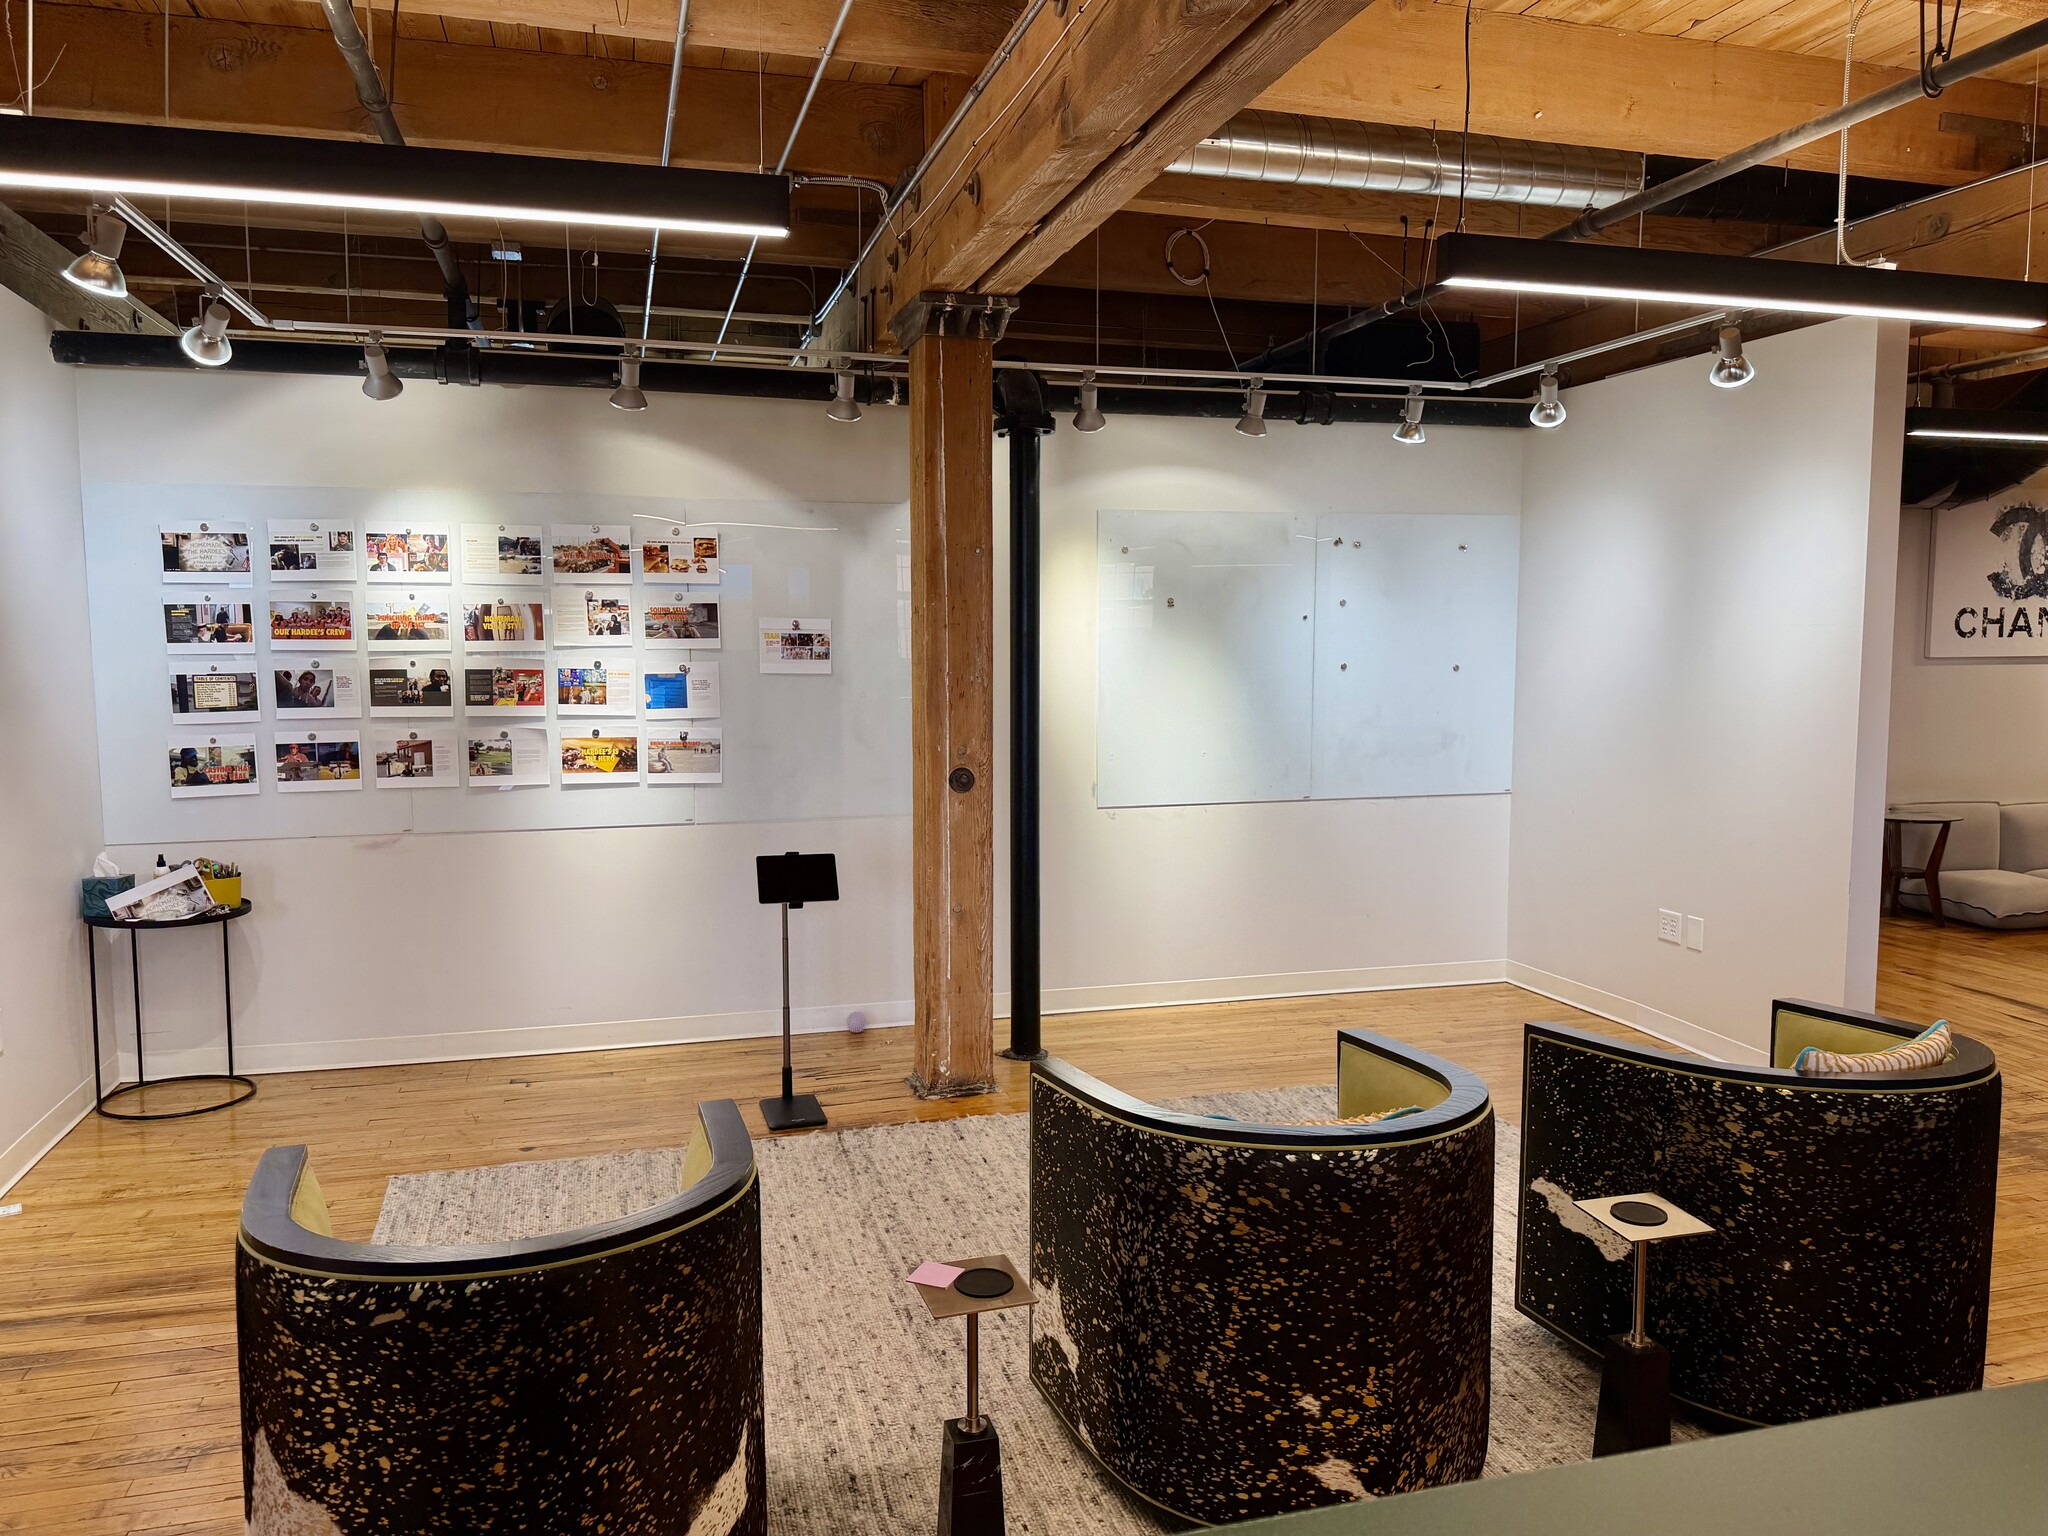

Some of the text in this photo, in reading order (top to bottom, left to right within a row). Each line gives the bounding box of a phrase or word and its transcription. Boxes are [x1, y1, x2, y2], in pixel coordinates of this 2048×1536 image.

[274, 628, 346, 636] OUR HARDEE'S CREW
